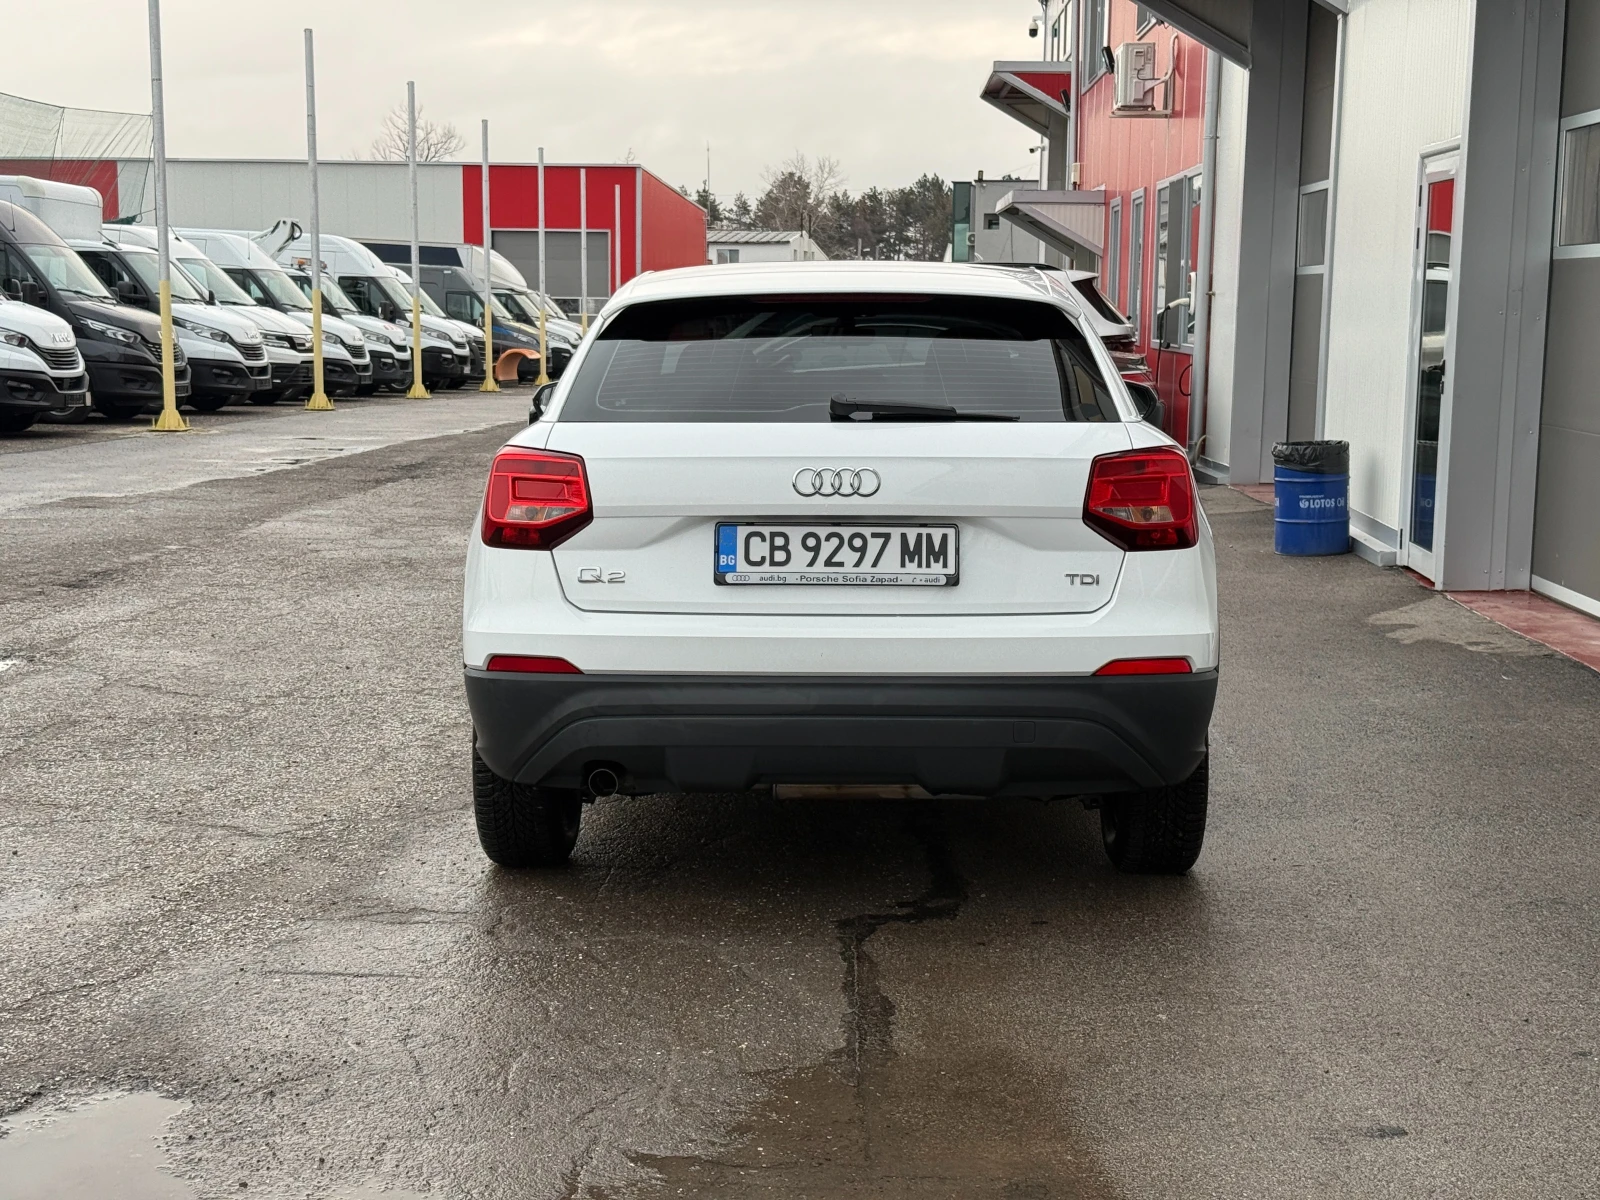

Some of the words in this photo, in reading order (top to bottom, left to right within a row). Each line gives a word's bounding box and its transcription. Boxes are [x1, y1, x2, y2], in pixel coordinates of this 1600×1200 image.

[1309, 498, 1336, 509] LOTOS
[743, 531, 792, 567] CB
[800, 531, 892, 568] 9297
[900, 532, 949, 569] MM
[720, 554, 736, 566] BG
[758, 574, 787, 583] audi.bg
[842, 575, 868, 583] Sofia
[1064, 573, 1100, 586] TDI
